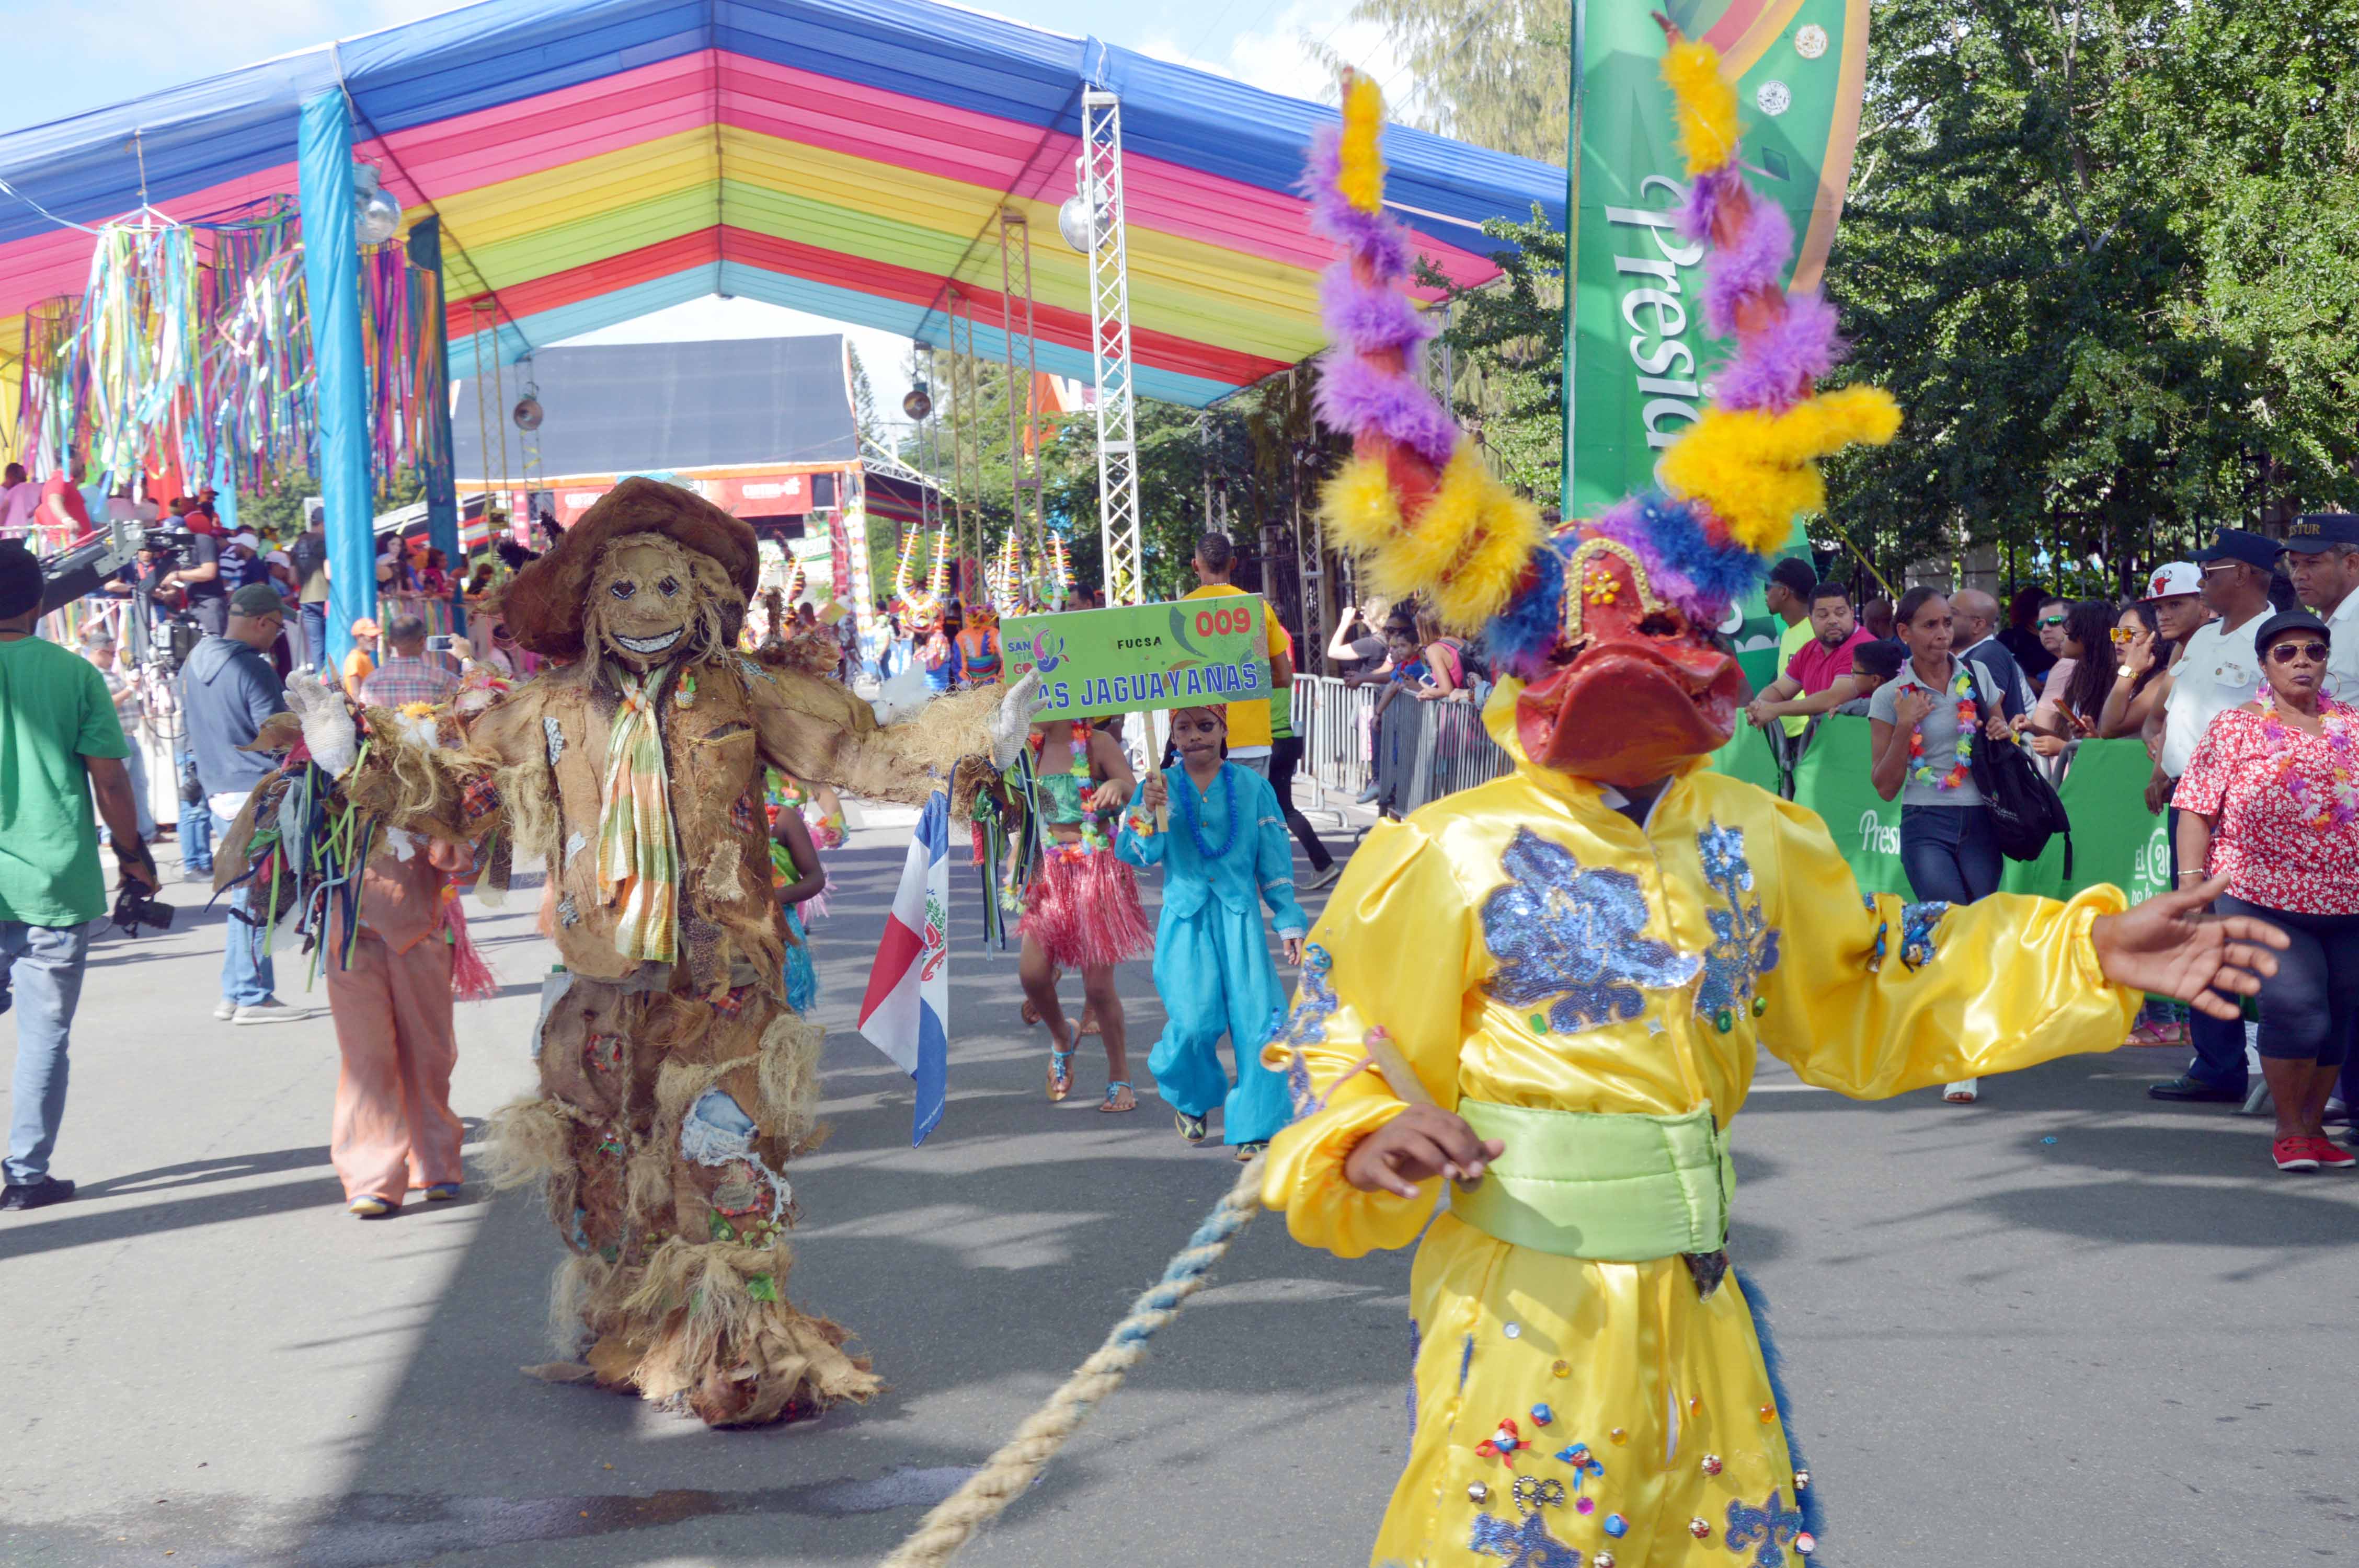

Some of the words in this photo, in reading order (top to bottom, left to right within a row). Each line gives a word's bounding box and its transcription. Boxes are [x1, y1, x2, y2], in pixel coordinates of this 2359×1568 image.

[1604, 174, 1719, 497] Presid
[2289, 523, 2320, 535] STUR
[1196, 607, 1251, 637] 009
[1007, 641, 1032, 653] SAN
[1117, 636, 1162, 649] FUCSA
[1013, 662, 1033, 675] GO
[1038, 682, 1070, 710] AS
[1080, 663, 1258, 707] JAGUAYANAS
